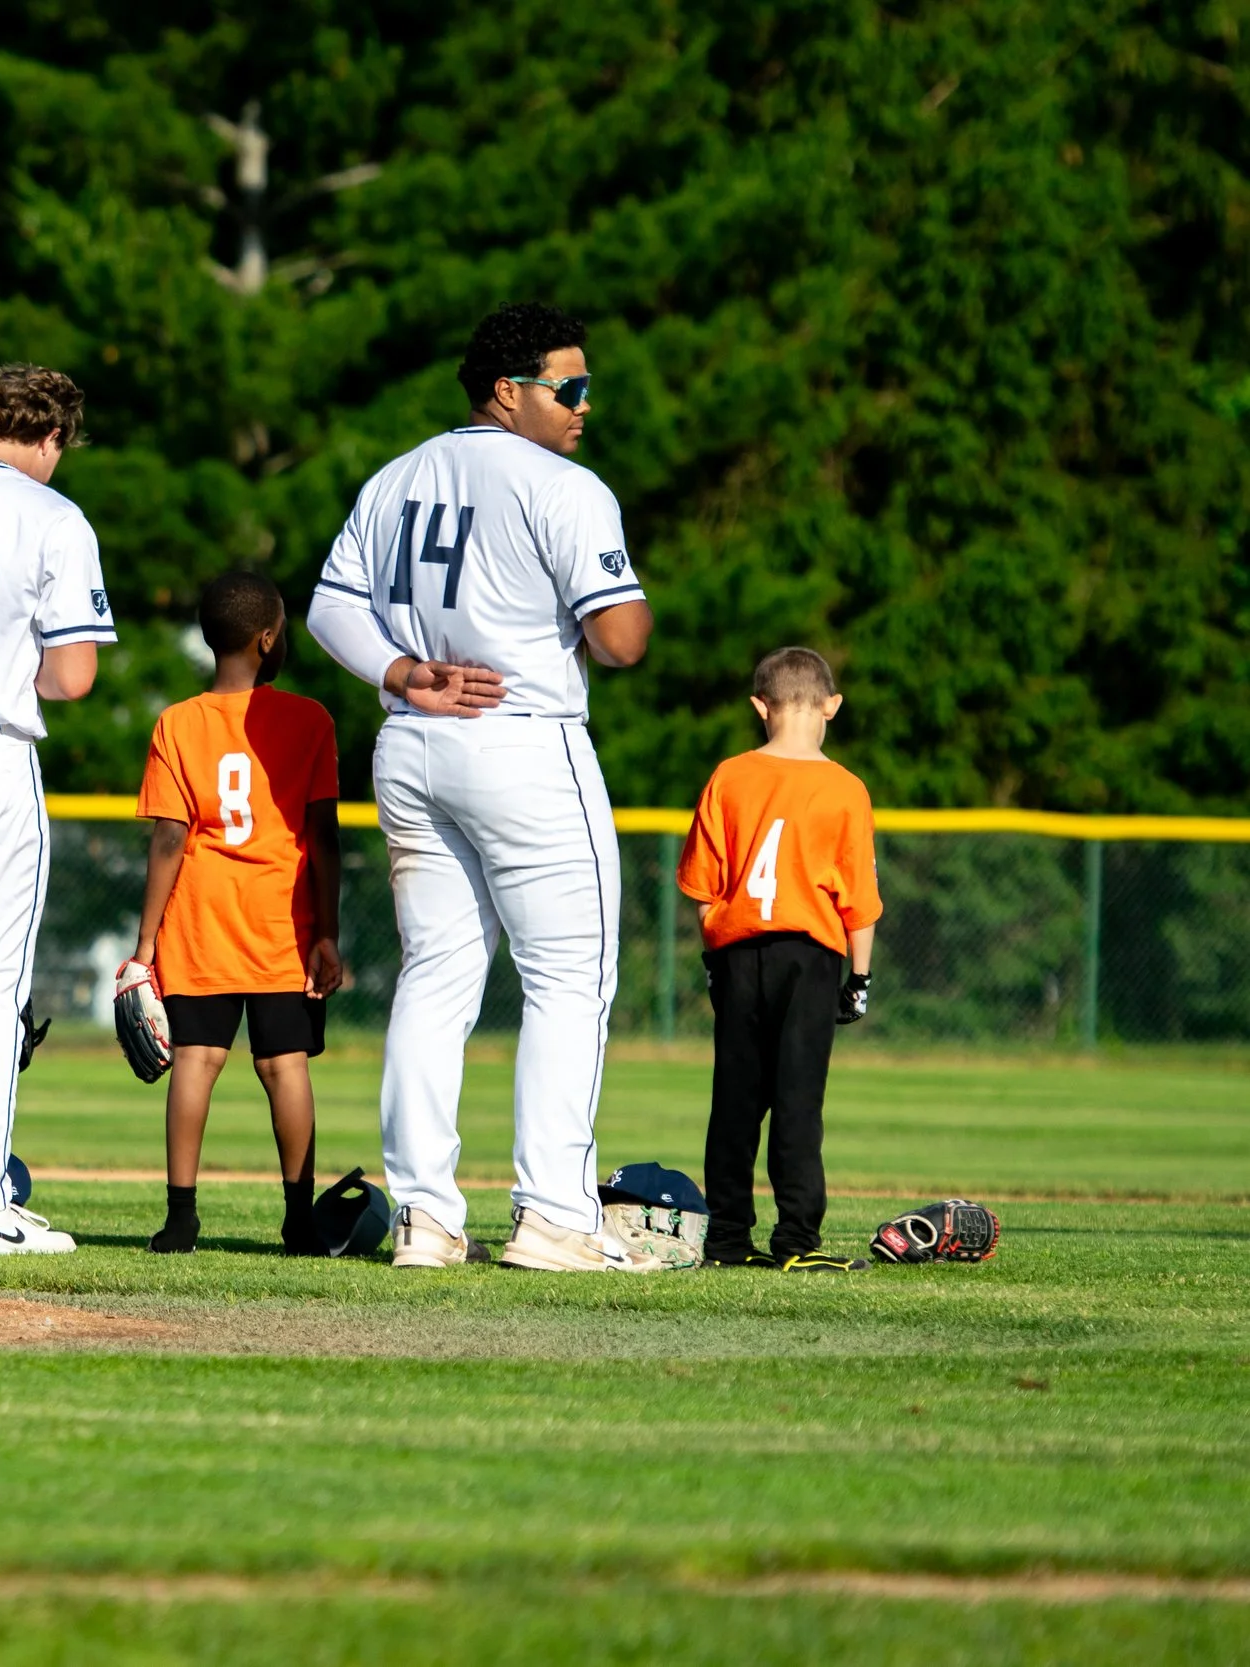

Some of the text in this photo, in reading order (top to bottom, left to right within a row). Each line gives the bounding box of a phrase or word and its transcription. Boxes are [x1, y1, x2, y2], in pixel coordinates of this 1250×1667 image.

[389, 499, 476, 610] 14
[217, 751, 254, 847] 8
[746, 818, 785, 921] 4
